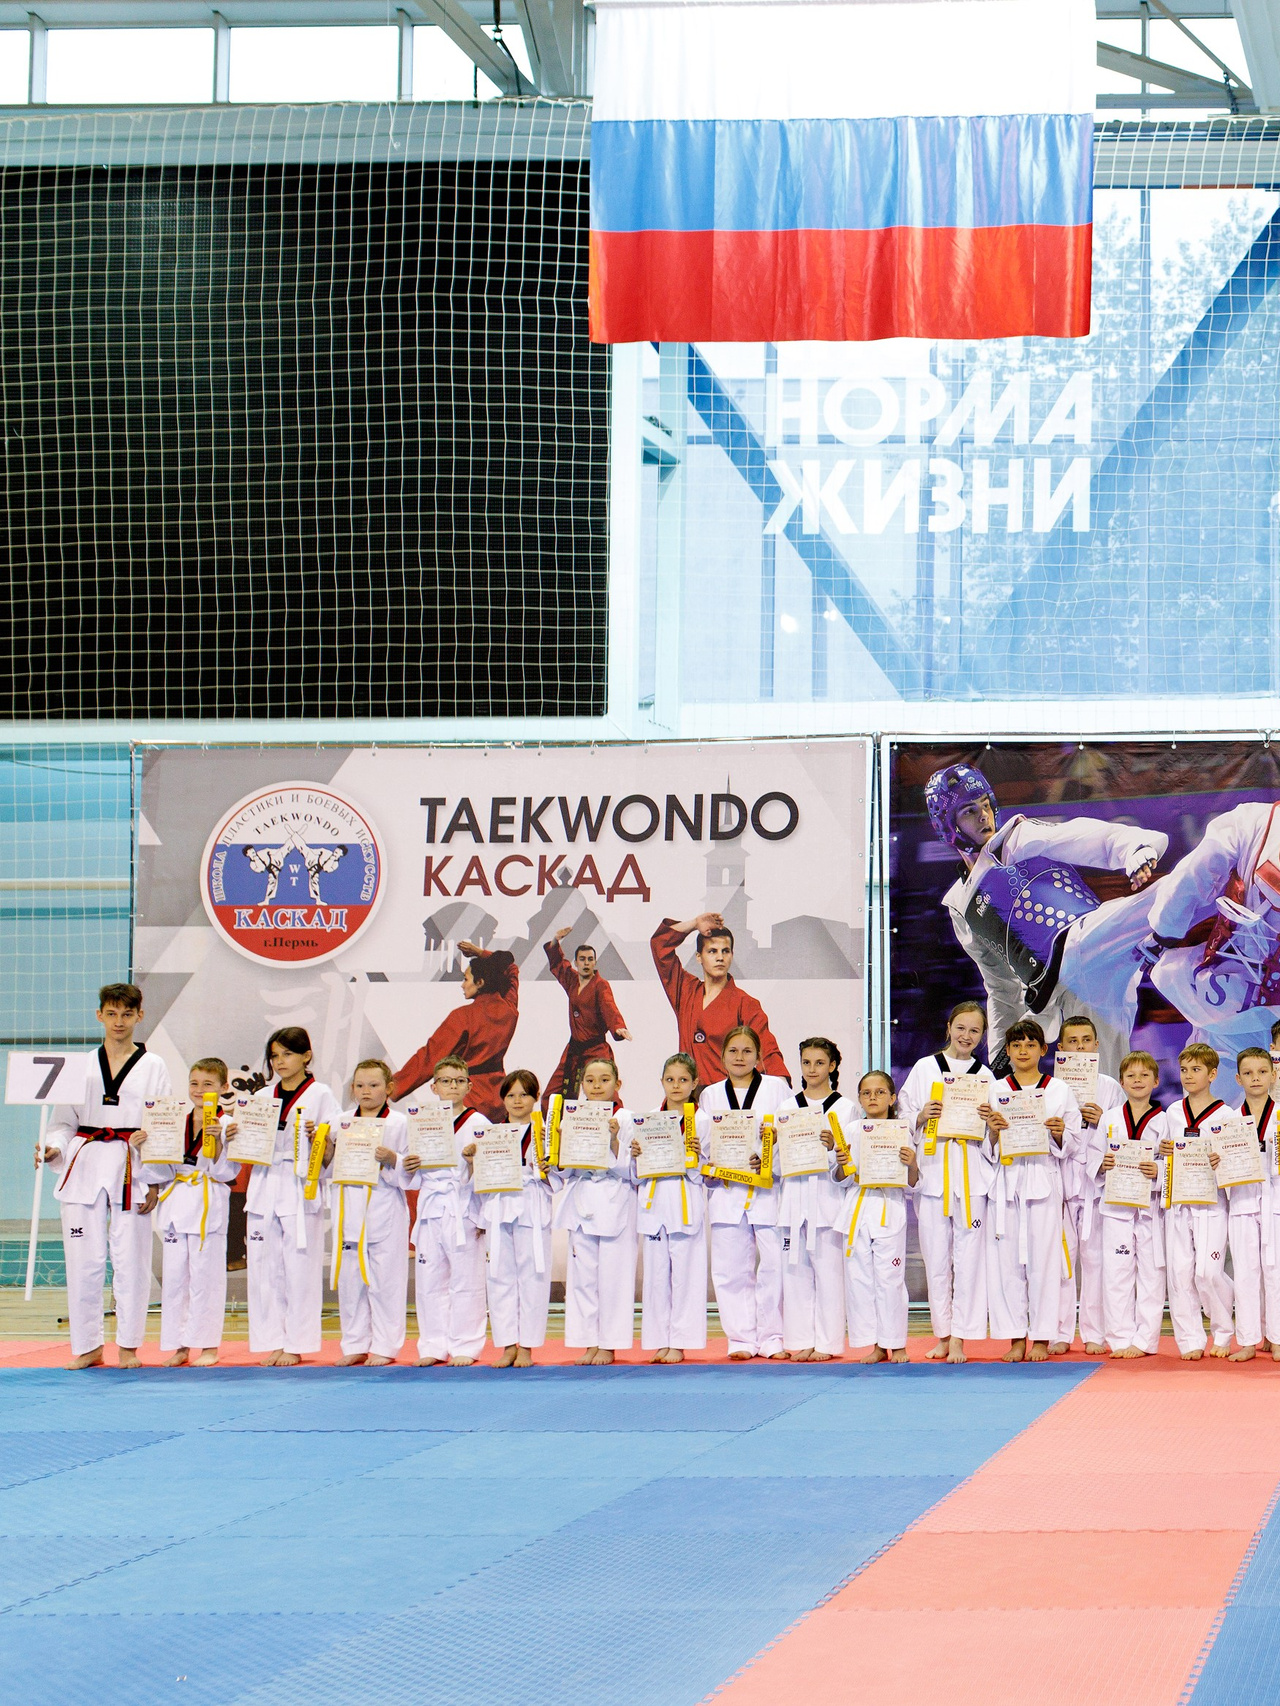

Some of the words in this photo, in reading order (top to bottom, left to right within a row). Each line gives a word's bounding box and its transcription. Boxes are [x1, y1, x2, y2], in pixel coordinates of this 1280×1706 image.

[766, 371, 1093, 447] НОРМА
[762, 458, 1091, 534] ЖИЗНИ
[253, 812, 340, 837] TAEKWONDO
[420, 792, 799, 845] TAEKWONDO
[211, 851, 227, 902] ШКОЛА
[221, 795, 284, 847] ПЛАСТИКИ
[291, 793, 299, 803] И
[307, 794, 358, 827] БОЕВЫХ
[355, 829, 376, 901] ИСКУССТВ
[424, 853, 651, 903] КАСКАД
[234, 908, 348, 932] КАСКАД
[264, 938, 319, 950] г.Пермь
[33, 1057, 65, 1099] 7
[308, 1140, 321, 1176] TAEKWONDO
[762, 1132, 771, 1169] TAEKWONDO
[718, 1169, 753, 1184] TAEKWONDO
[1163, 1163, 1171, 1199] TAEKWONDO
